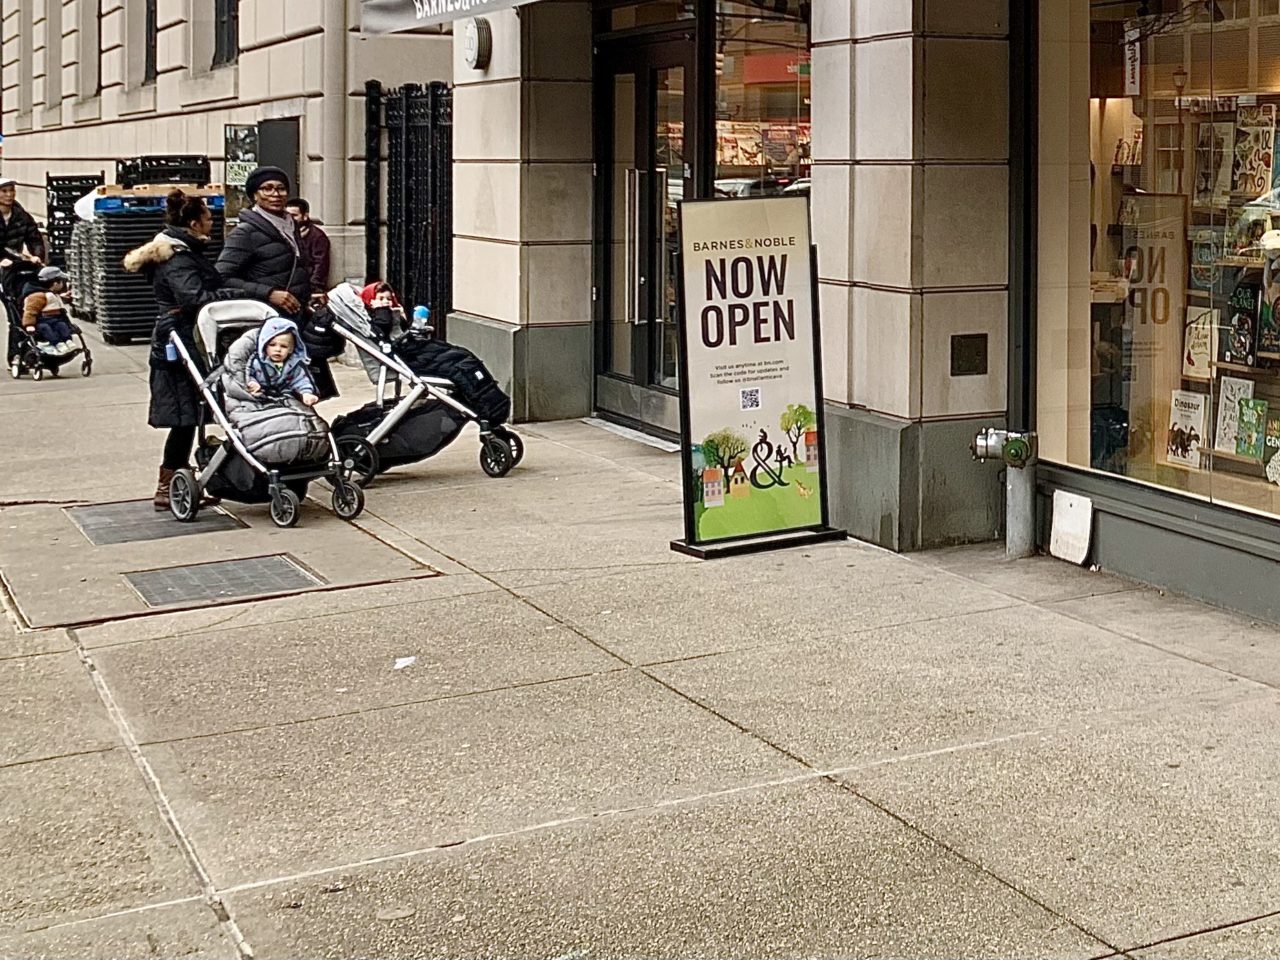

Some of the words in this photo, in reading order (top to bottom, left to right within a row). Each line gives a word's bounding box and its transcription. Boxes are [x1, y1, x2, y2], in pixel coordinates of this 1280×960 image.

[704, 254, 788, 301] NOW
[701, 299, 796, 349] OPEN
[1174, 398, 1200, 411] Dinosaur
